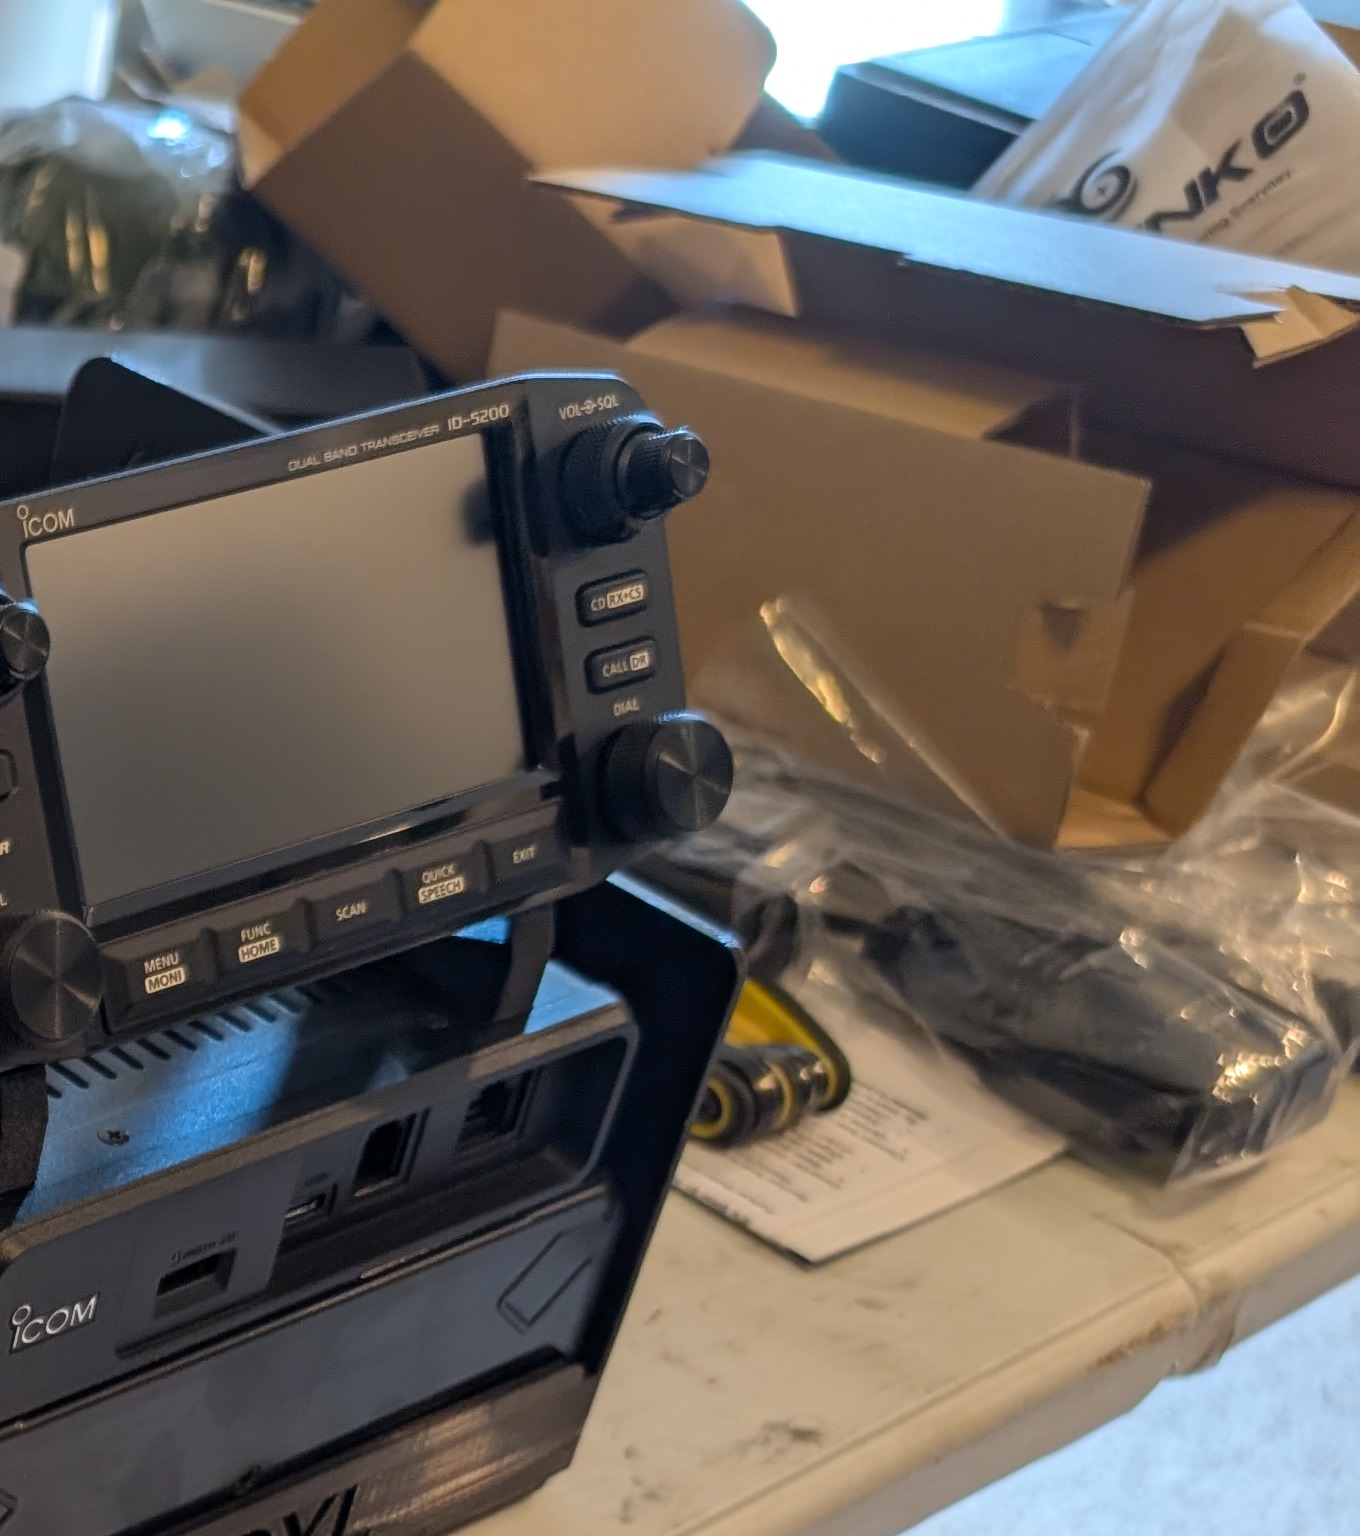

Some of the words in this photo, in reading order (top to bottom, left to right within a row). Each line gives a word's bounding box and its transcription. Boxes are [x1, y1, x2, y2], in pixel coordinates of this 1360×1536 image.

[287, 453, 321, 472] DUAL
[323, 445, 358, 463] BAND
[361, 424, 440, 452] TRANSCEIVER
[447, 403, 510, 431] ID-5200
[609, 586, 643, 607] RX+CS
[602, 660, 629, 677] CALL
[631, 653, 647, 669] DR
[613, 697, 640, 716] DIAL
[421, 864, 457, 884] QUICK
[420, 877, 462, 901] SPEECH
[335, 901, 367, 922] SCAN
[240, 922, 272, 942] FUNC
[240, 937, 278, 961] HOME
[143, 951, 179, 975] MENU
[147, 969, 183, 993] MONI
